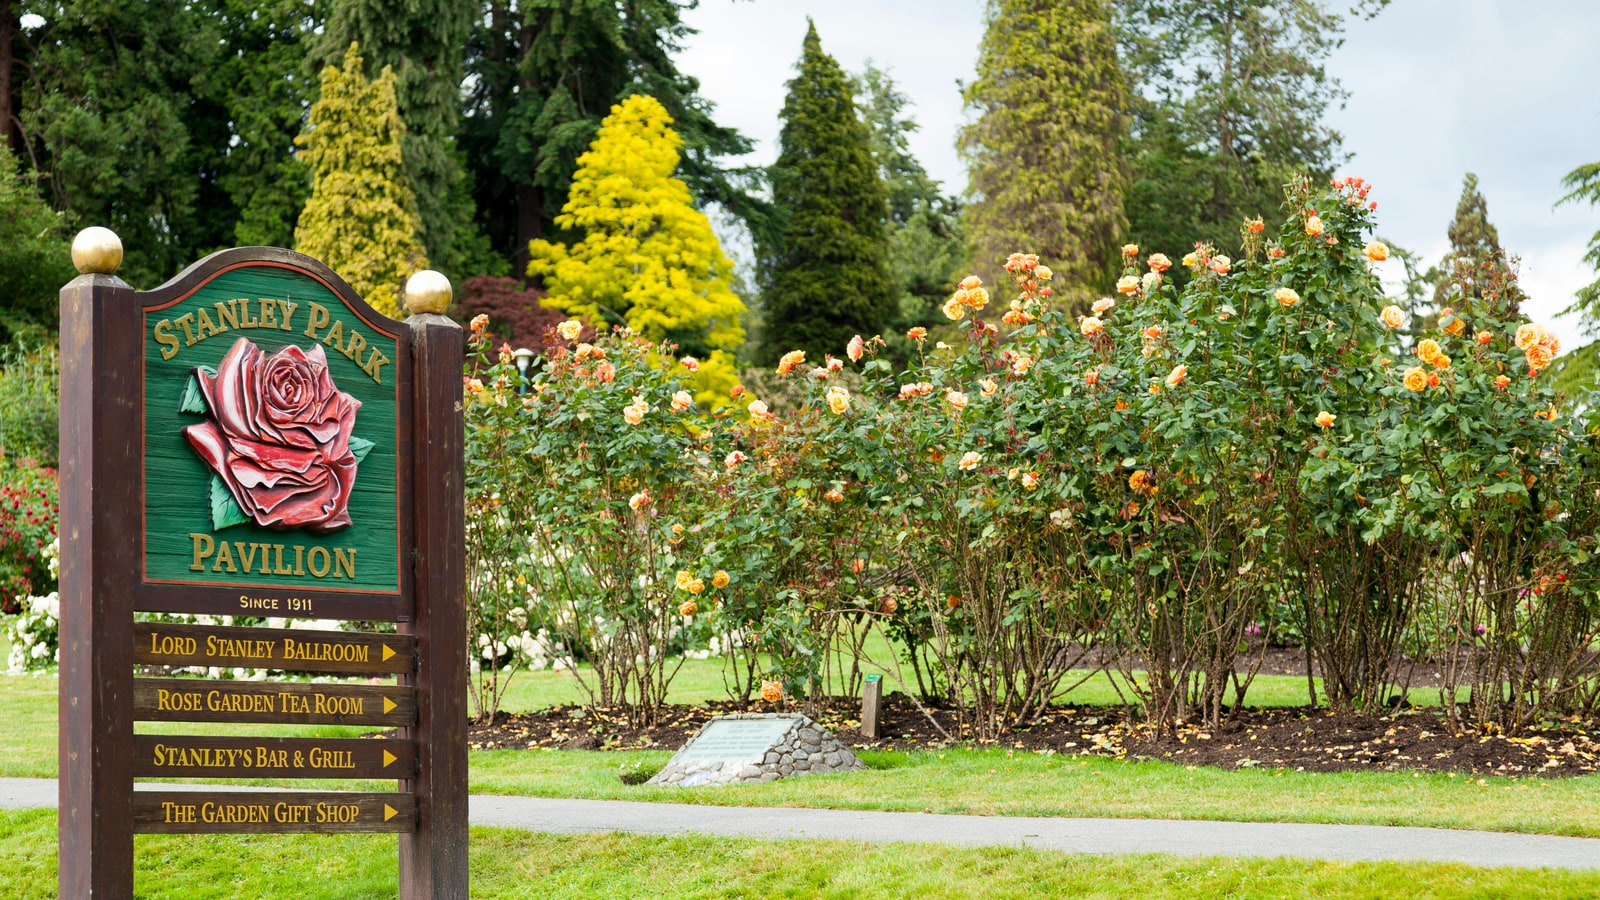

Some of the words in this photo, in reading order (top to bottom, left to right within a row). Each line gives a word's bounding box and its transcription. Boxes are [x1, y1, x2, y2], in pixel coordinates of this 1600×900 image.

[154, 298, 298, 360] STANLEY
[304, 301, 391, 384] PARK
[189, 533, 357, 579] PAVILION
[240, 596, 279, 610] SINCE
[287, 599, 313, 611] 1911
[151, 633, 197, 655] LORD
[206, 635, 275, 658] STANLEY
[284, 638, 369, 662] BALLROOM
[158, 689, 203, 711] ROSE
[207, 690, 275, 713] GARDEN
[278, 692, 310, 714] TEA
[314, 694, 364, 715] ROOM
[153, 743, 253, 768] STANLEY'S
[256, 747, 289, 768] BAR
[293, 750, 305, 768] &
[309, 747, 356, 769] GRILL
[162, 801, 197, 823] THE
[201, 802, 270, 824] GARDEN
[274, 802, 312, 823] GIFT
[316, 802, 360, 823] SHOP
